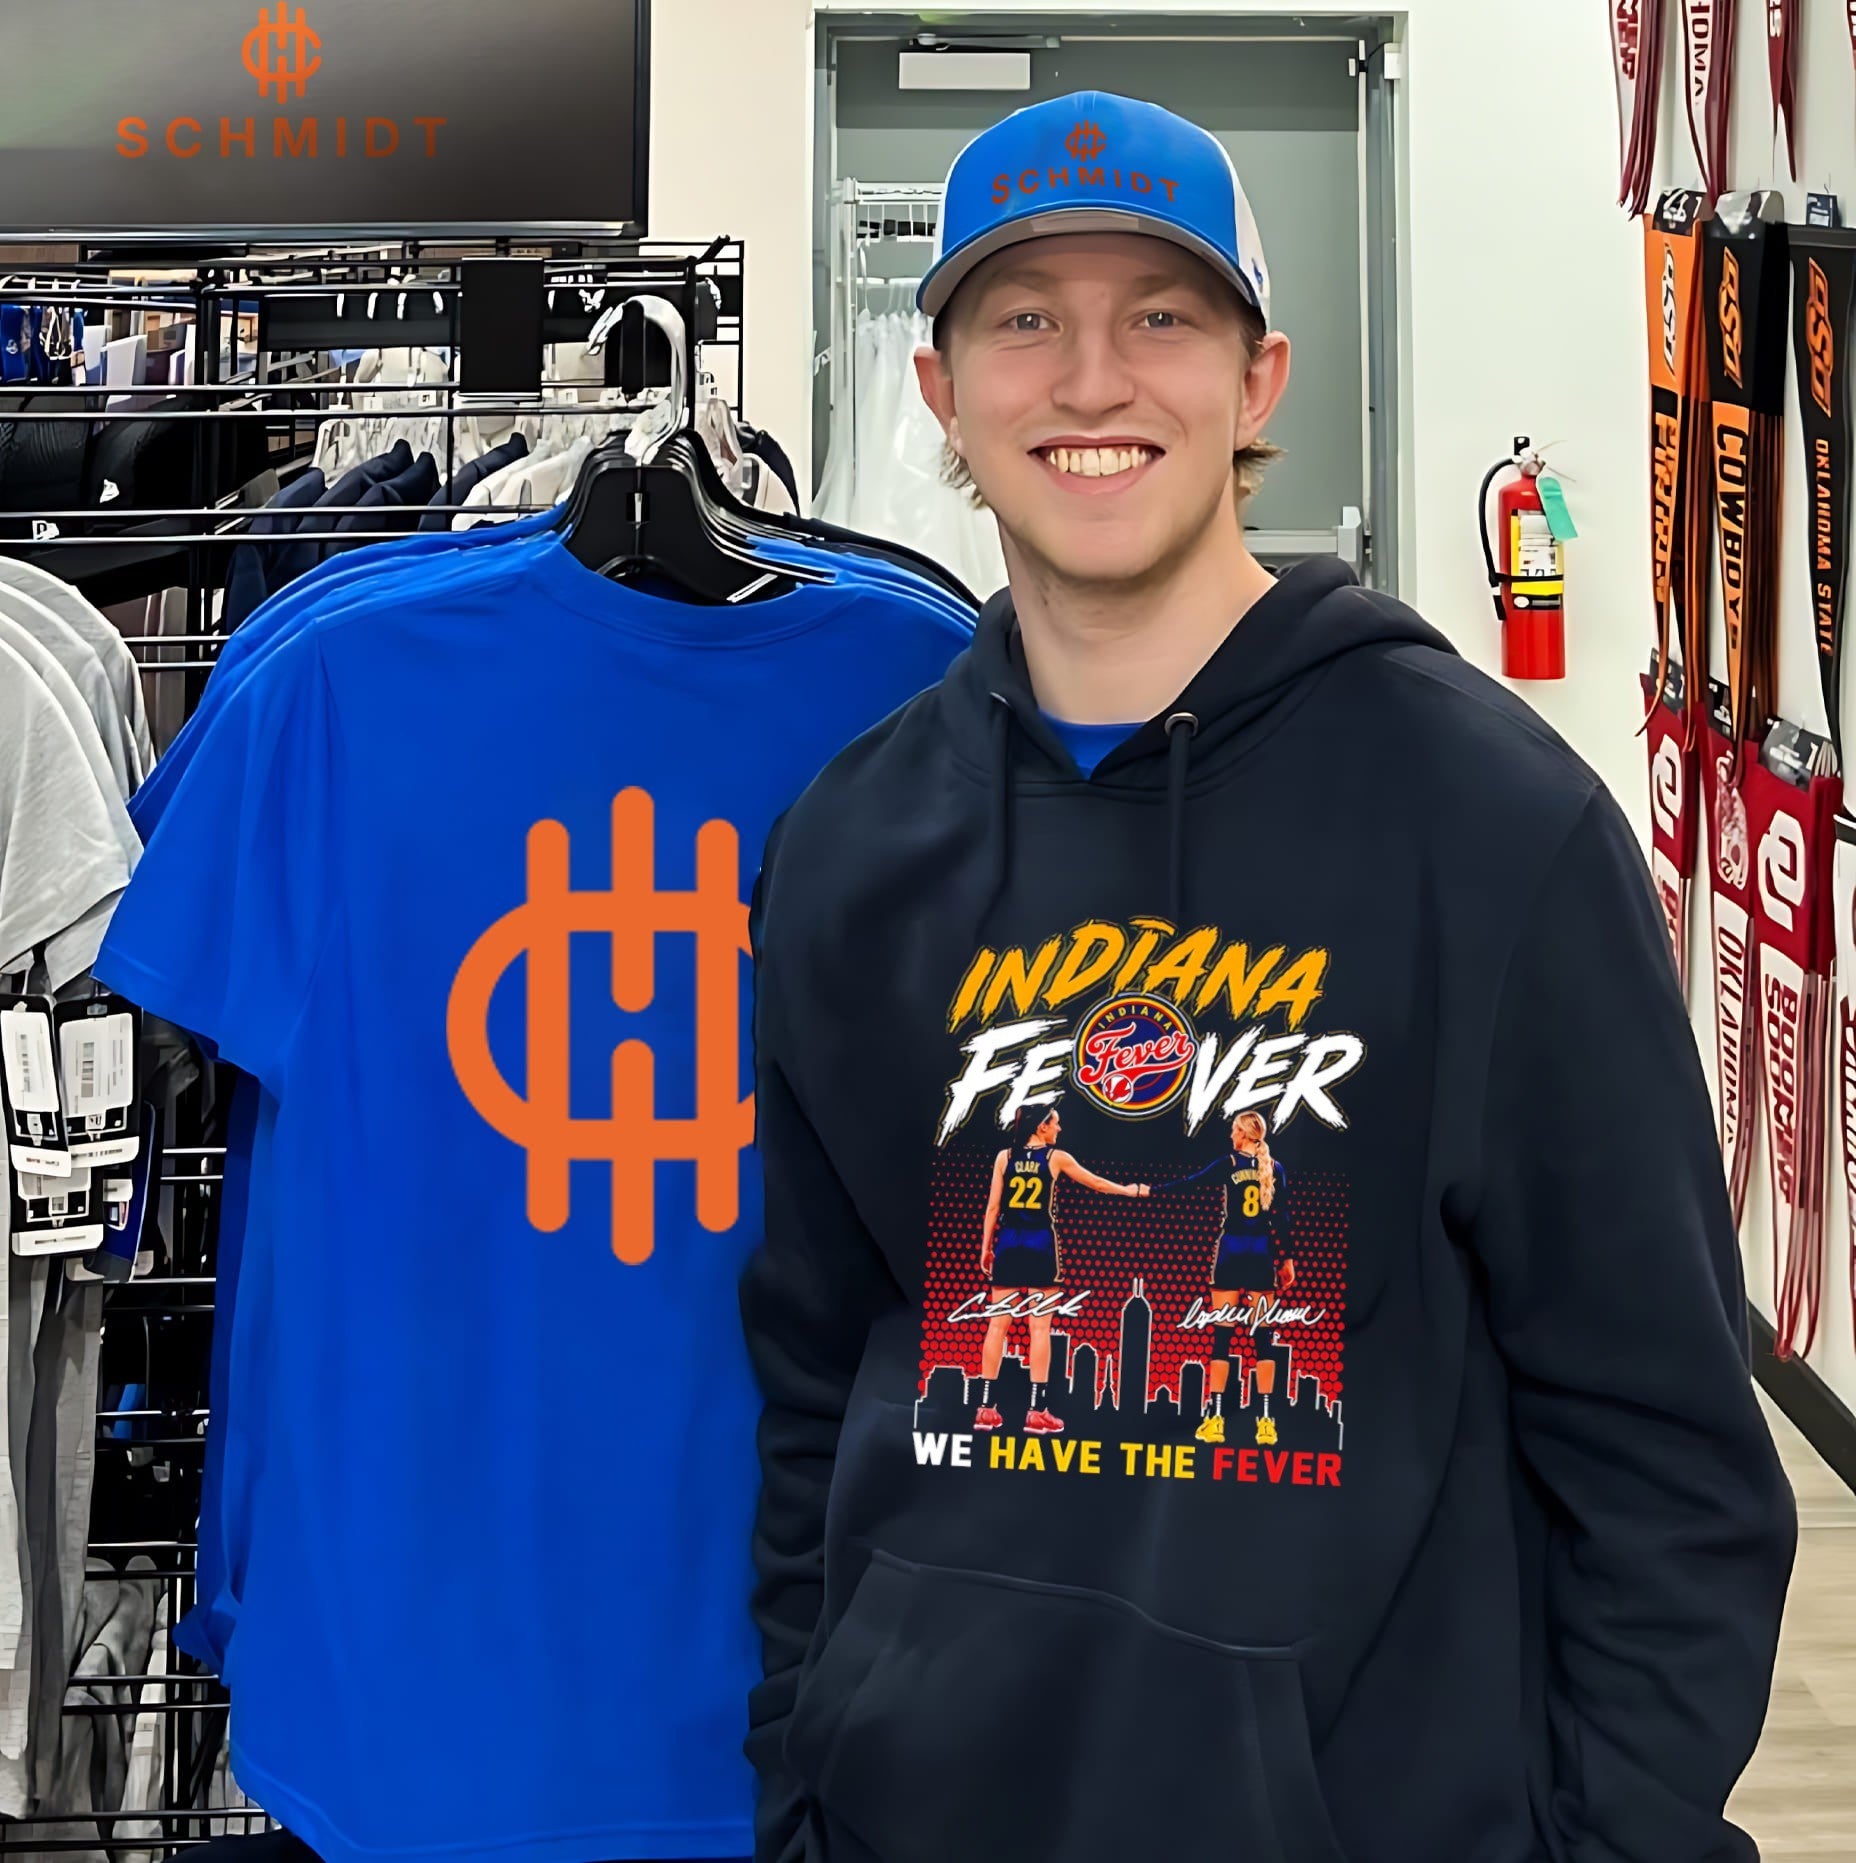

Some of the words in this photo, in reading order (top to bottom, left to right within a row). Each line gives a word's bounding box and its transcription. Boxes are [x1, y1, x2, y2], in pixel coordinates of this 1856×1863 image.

[115, 117, 447, 158] SCHMIDT
[992, 167, 1179, 204] SCHMIDT
[1816, 438, 1833, 570] OKLAHOMA
[949, 916, 1329, 1031] INDIANA
[1098, 1005, 1172, 1030] INDIANA
[1718, 925, 1744, 1144] OKLAHOMA
[1078, 1021, 1194, 1086] Fever
[1014, 1160, 1041, 1174] CLARK
[1009, 1176, 1043, 1209] 22
[1242, 1185, 1260, 1218] 8
[912, 1432, 972, 1467] WE
[989, 1436, 1100, 1474] HAVE
[1119, 1442, 1195, 1479] THE
[1213, 1448, 1342, 1487] FEVER
